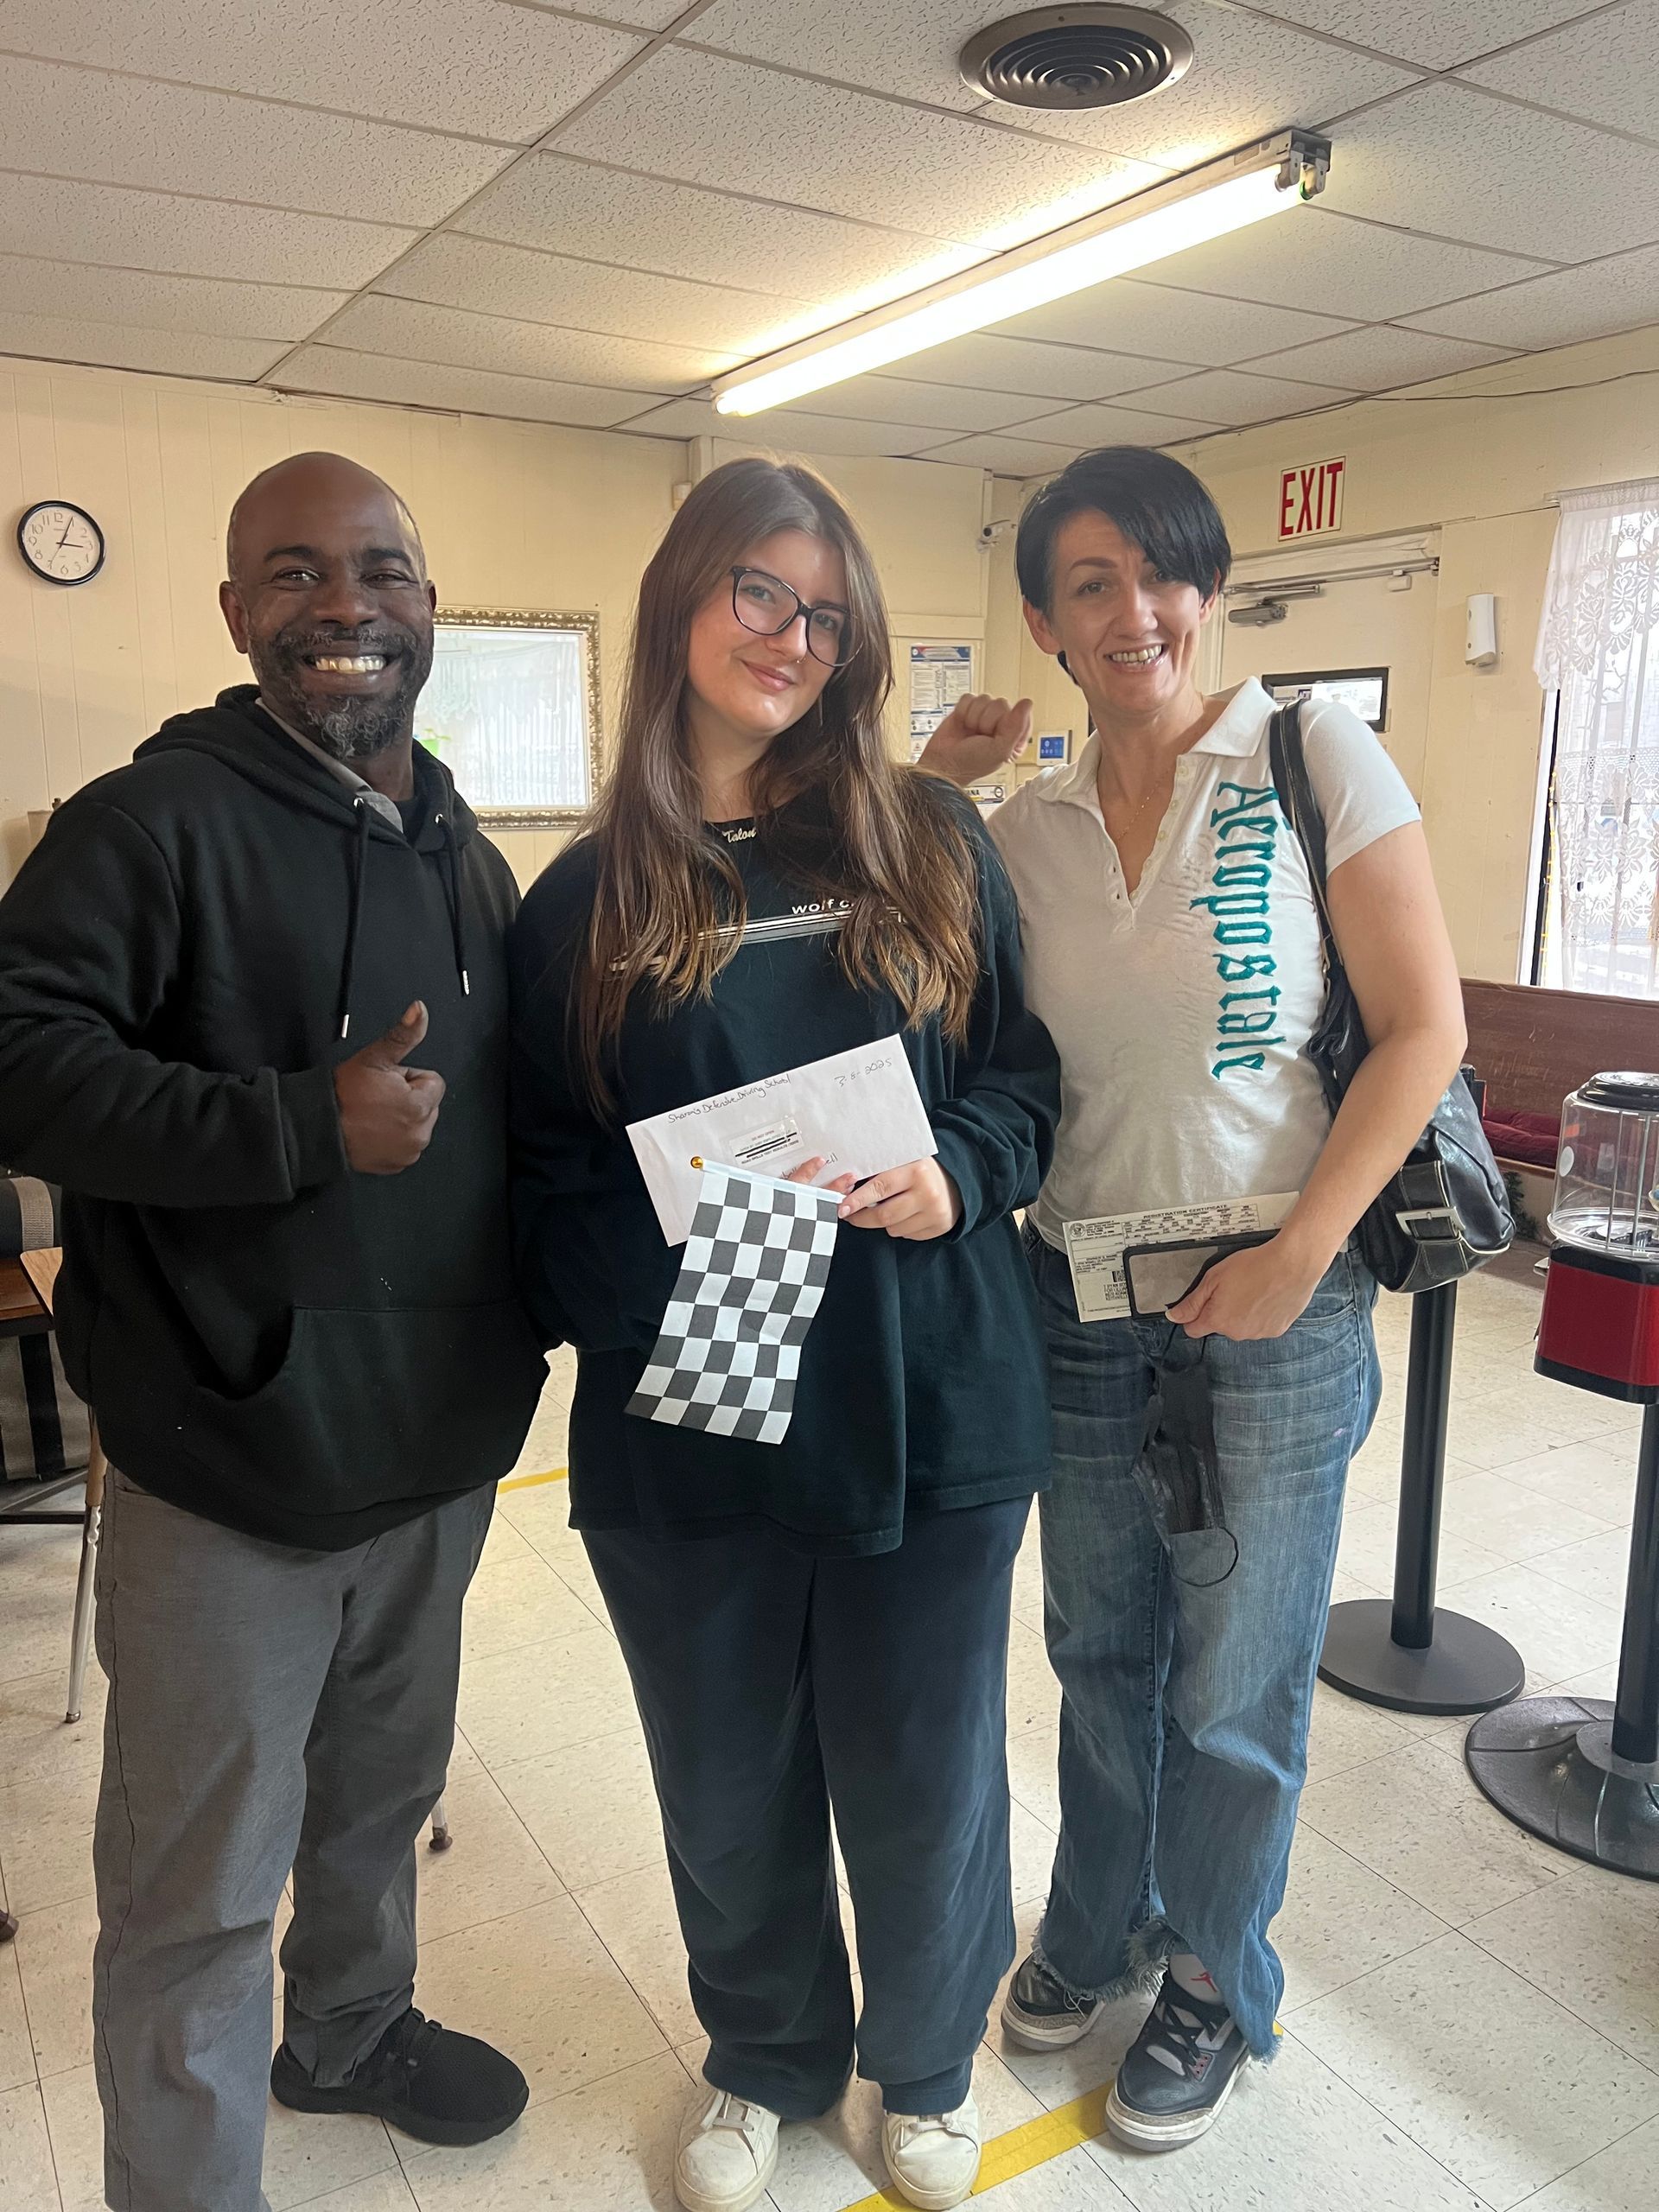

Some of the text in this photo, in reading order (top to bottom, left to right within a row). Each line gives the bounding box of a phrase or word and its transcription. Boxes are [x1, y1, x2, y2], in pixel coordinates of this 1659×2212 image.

[1280, 461, 1344, 537] EXIT
[32, 524, 43, 534] 10
[29, 536, 37, 546] 9
[35, 550, 43, 559] 8
[60, 565, 68, 575] 6
[791, 899, 835, 915] wolf
[736, 1085, 766, 1101] Driving
[764, 1073, 791, 1089] School
[1189, 1205, 1227, 1213] CERTIFICATE
